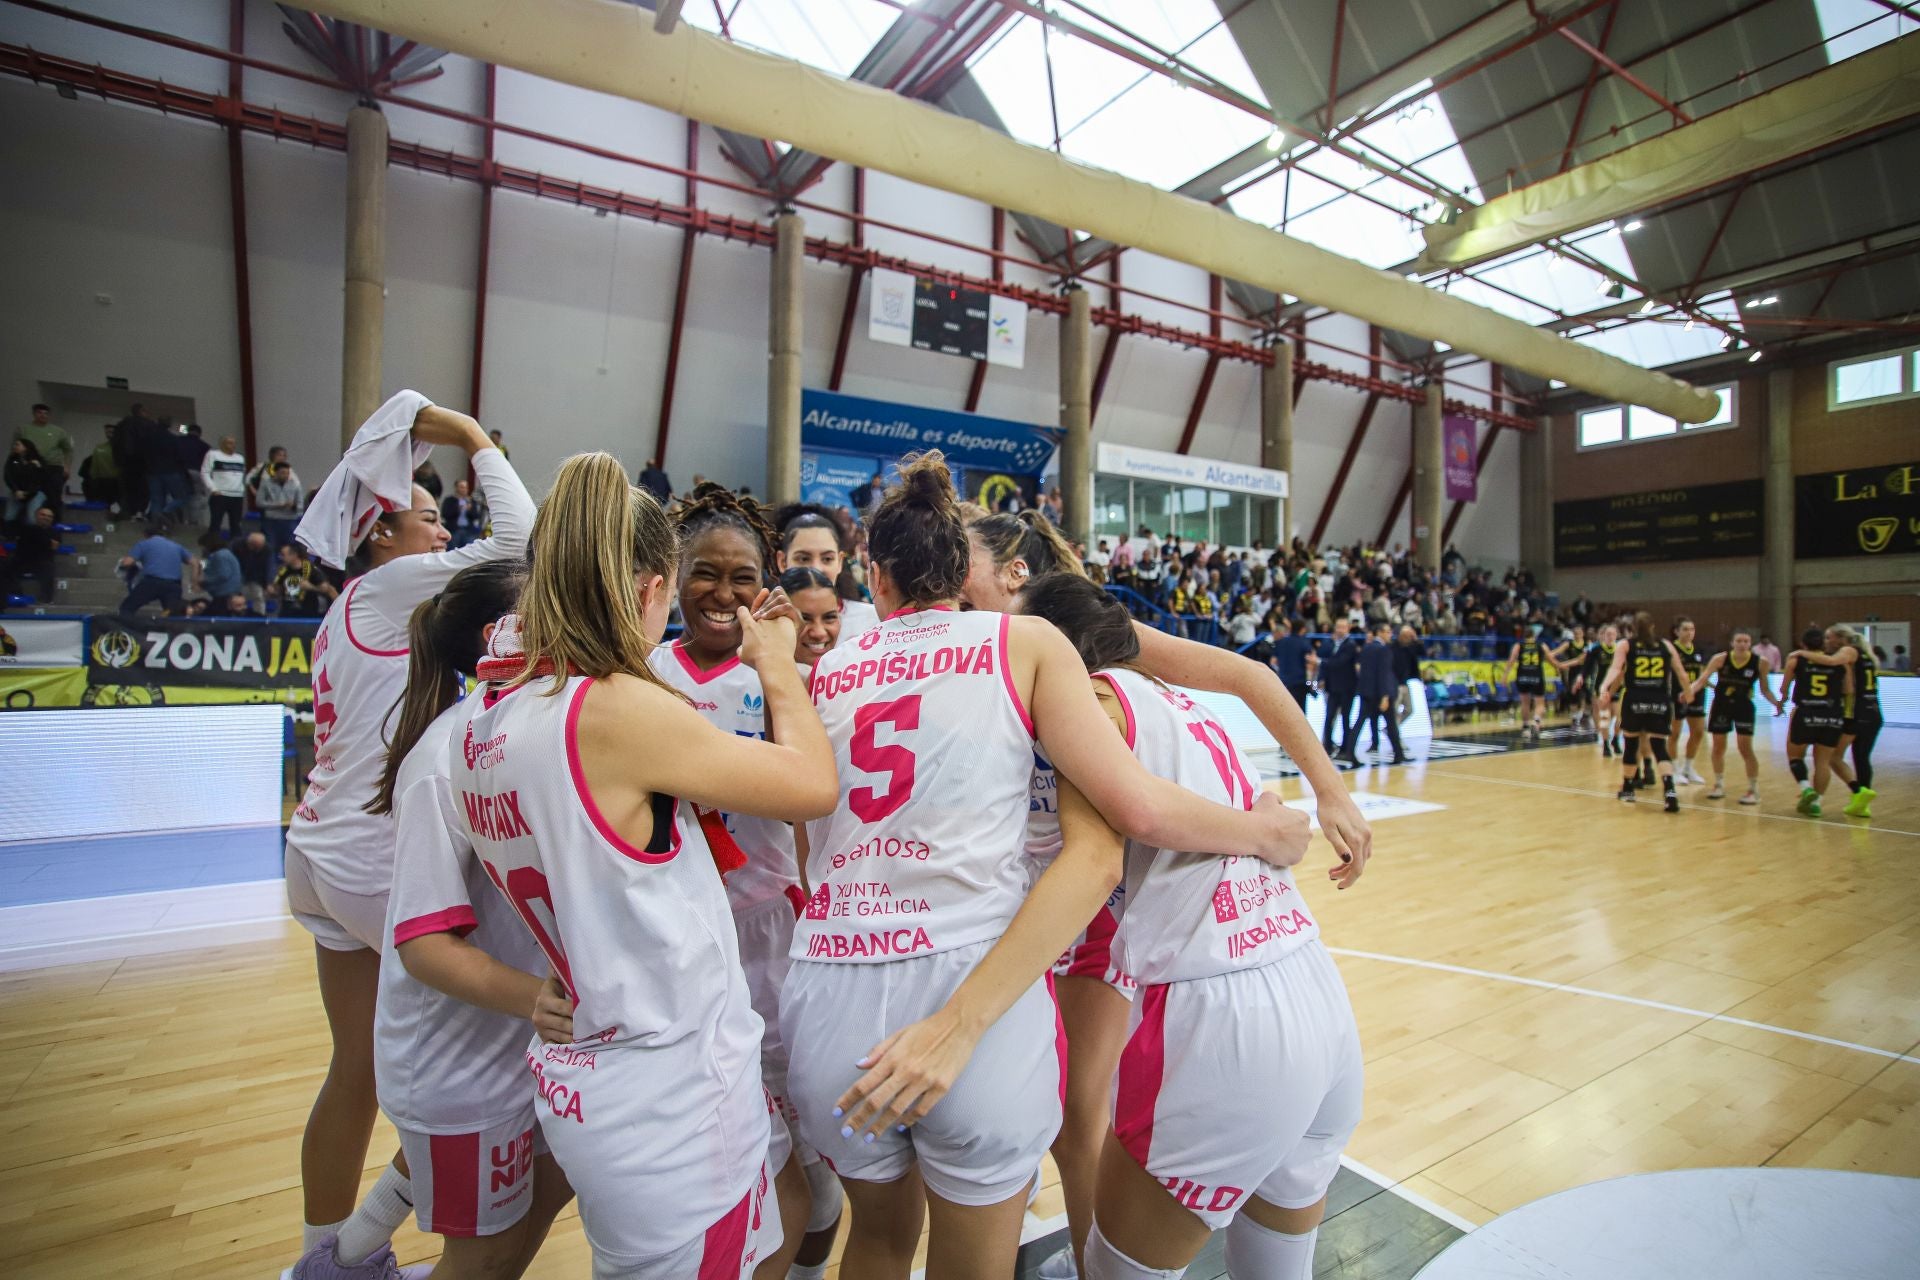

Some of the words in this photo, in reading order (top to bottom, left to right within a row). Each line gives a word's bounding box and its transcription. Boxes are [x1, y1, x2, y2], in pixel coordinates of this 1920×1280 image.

[803, 409, 918, 441] Alcantarilla
[922, 430, 943, 443] es
[947, 430, 1018, 454] deporte
[1206, 464, 1282, 493] Alcantarilla
[1833, 474, 1878, 502] La
[885, 637, 899, 646] DA
[266, 636, 316, 677] JA
[1635, 655, 1665, 678] 22
[813, 637, 994, 706] POSPÍŠILOVÁ
[1810, 674, 1828, 697] 5
[848, 694, 922, 824] 5
[462, 790, 532, 841] MATAIX
[837, 882, 892, 898] XUNTA
[832, 901, 850, 917] DE
[857, 898, 931, 916] GALICIA
